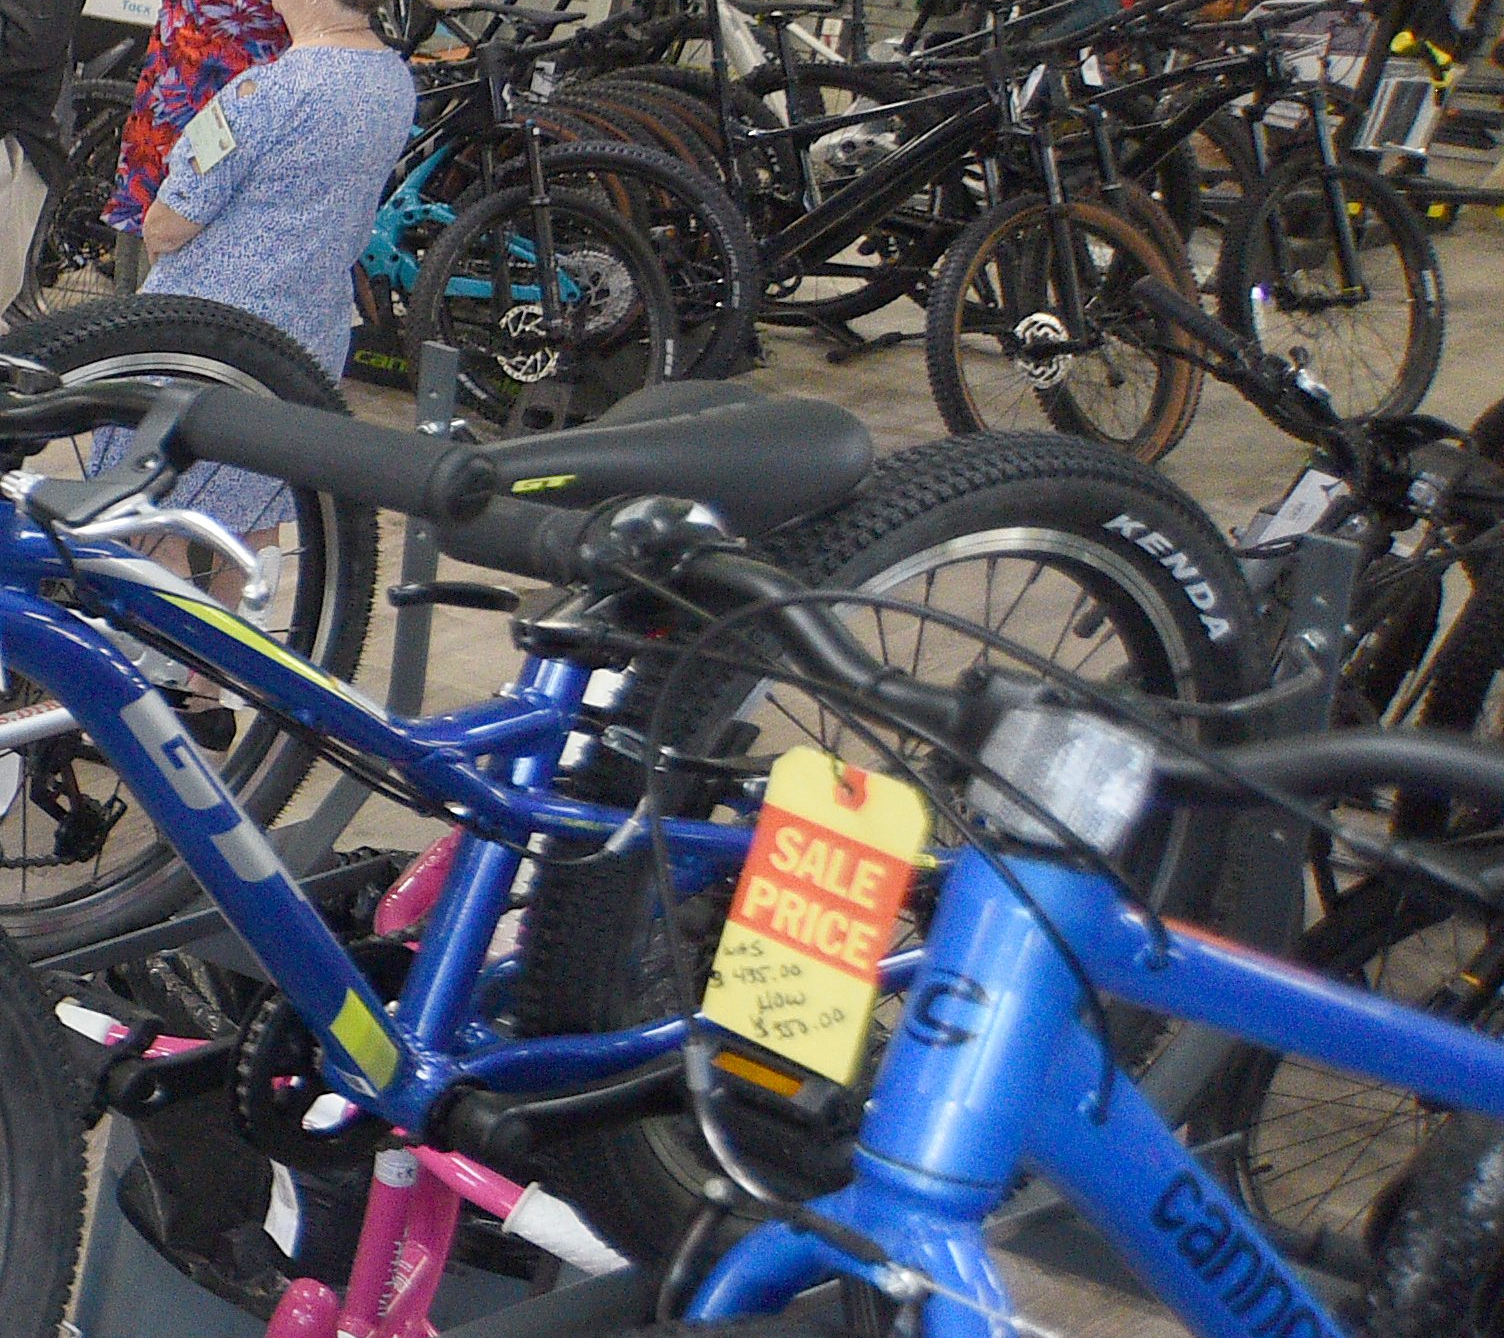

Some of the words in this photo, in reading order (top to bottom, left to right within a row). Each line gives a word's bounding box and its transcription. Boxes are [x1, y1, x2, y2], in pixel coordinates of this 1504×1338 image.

[1102, 513, 1231, 641] KENDA
[769, 825, 887, 910] SALE
[741, 876, 879, 971] PRICE
